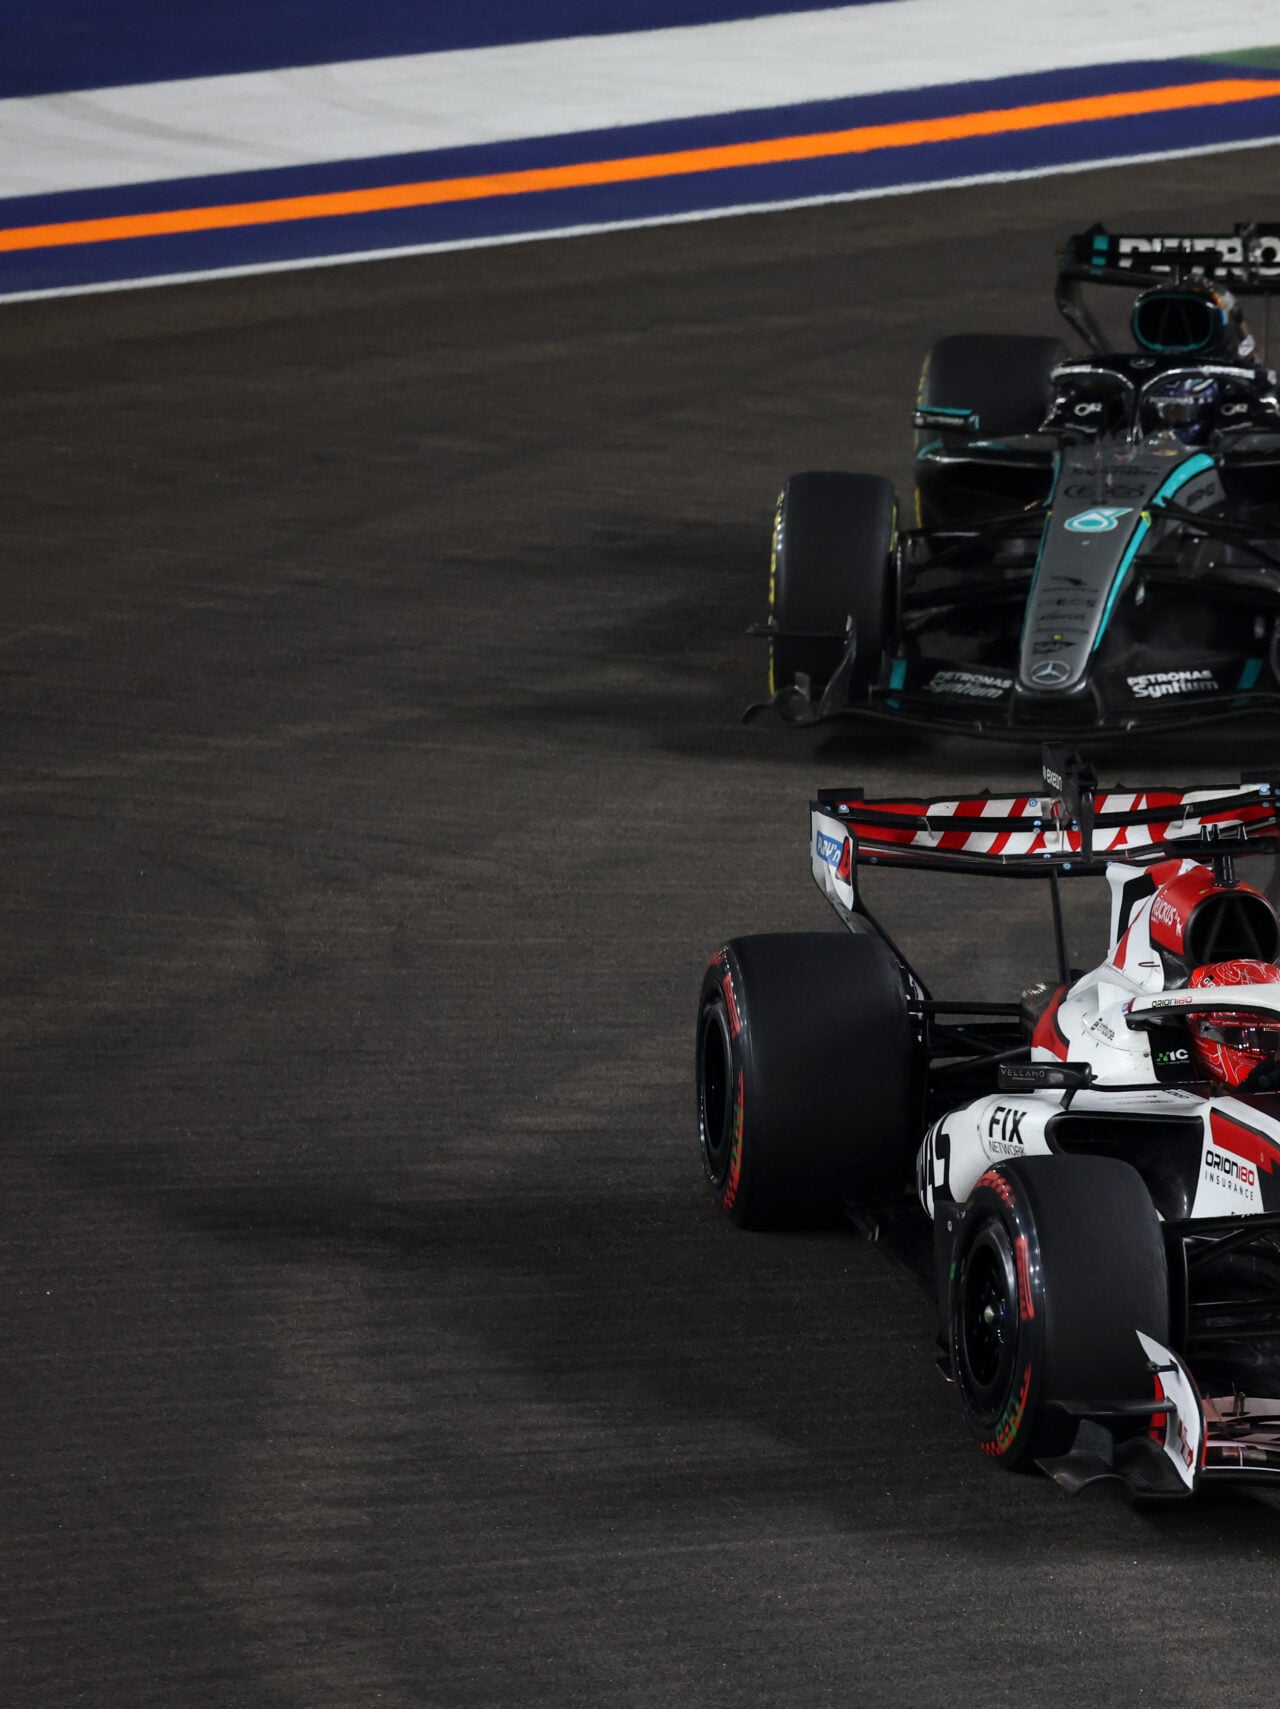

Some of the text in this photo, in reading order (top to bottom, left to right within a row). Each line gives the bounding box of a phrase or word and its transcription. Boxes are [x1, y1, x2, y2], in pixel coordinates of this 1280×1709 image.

[934, 671, 1013, 689] PETRONAS
[1127, 669, 1213, 688] PETRONAS
[1131, 679, 1219, 699] Syntium
[1001, 1068, 1045, 1079] VELLAMO
[989, 1106, 1027, 1144] FIX
[989, 1140, 1025, 1157] NETWORK
[1205, 1150, 1255, 1187] ORION180
[1205, 1171, 1254, 1201] INSURANCE
